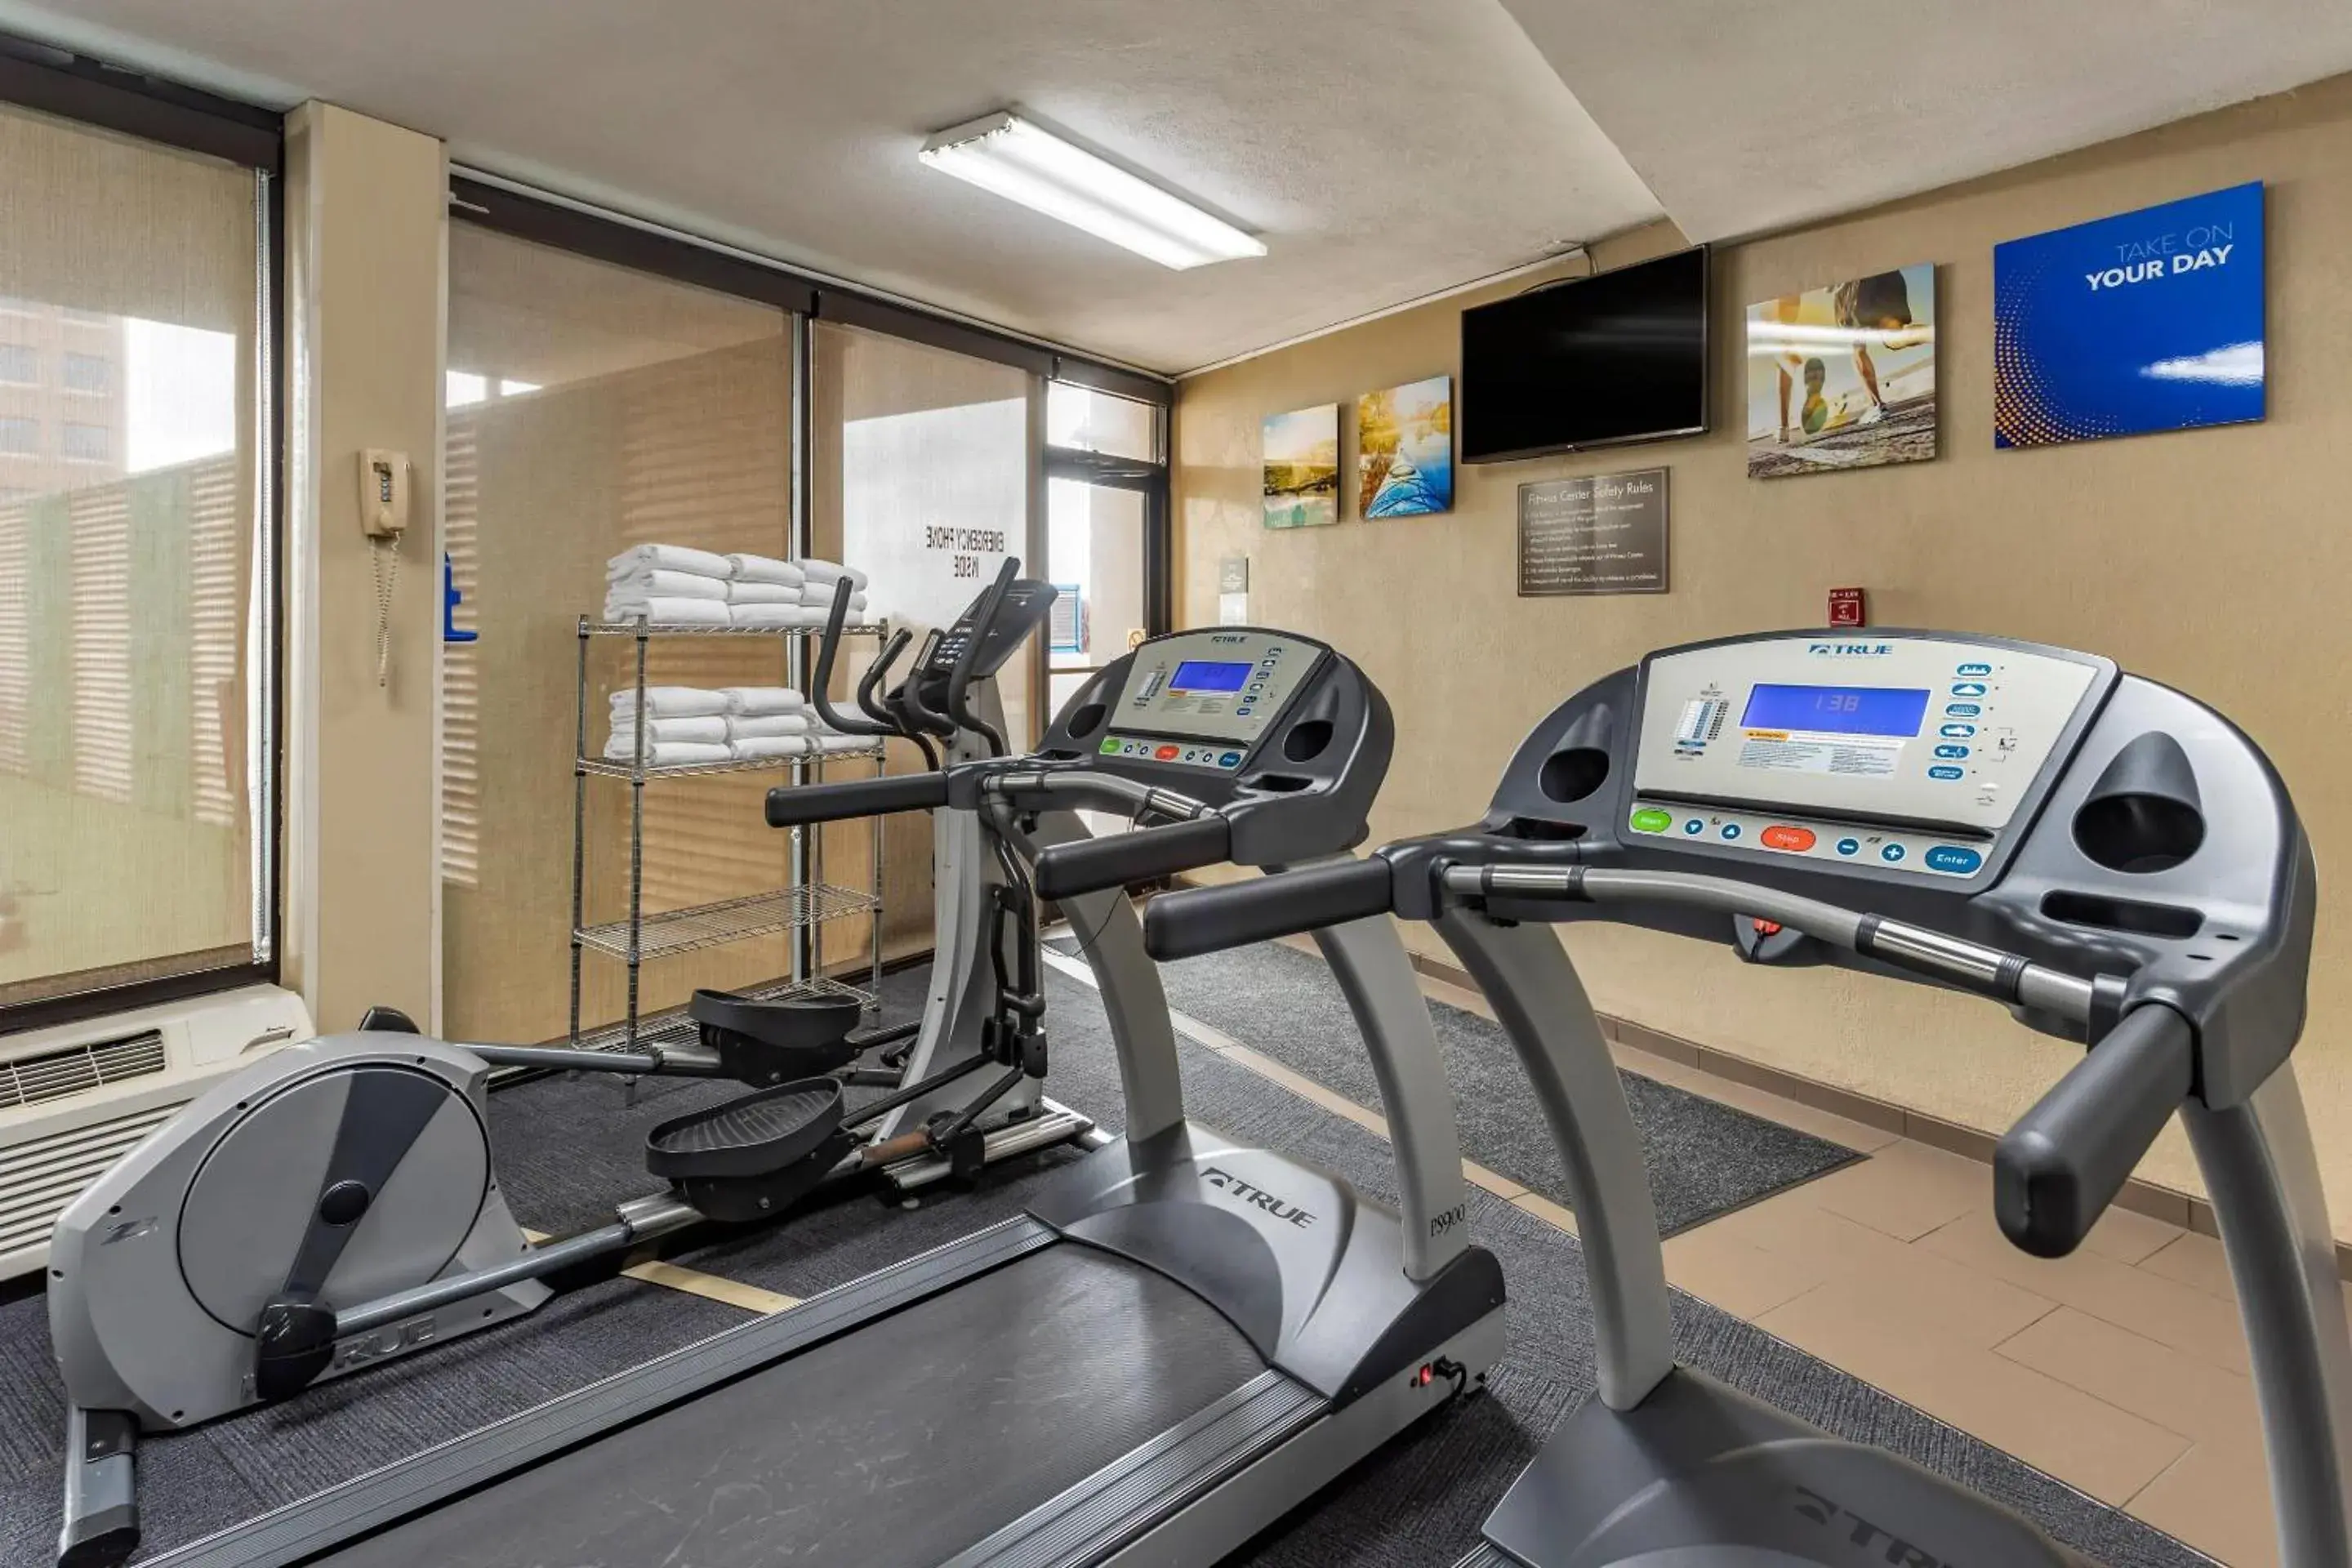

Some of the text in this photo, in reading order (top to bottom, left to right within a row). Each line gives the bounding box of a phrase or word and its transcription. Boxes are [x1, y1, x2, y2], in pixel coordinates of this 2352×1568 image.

[2117, 220, 2233, 262] TAKE ON
[2086, 244, 2234, 291] YOUR DAY
[1560, 489, 1592, 501] Center
[1593, 485, 1624, 499] Safety
[1627, 480, 1654, 494] Rules
[1836, 644, 1893, 654] TRUE
[1935, 853, 1970, 866] Enter
[1229, 1180, 1317, 1229] TRUE
[333, 1313, 435, 1370] RUE
[1842, 1509, 1953, 1568] TR
